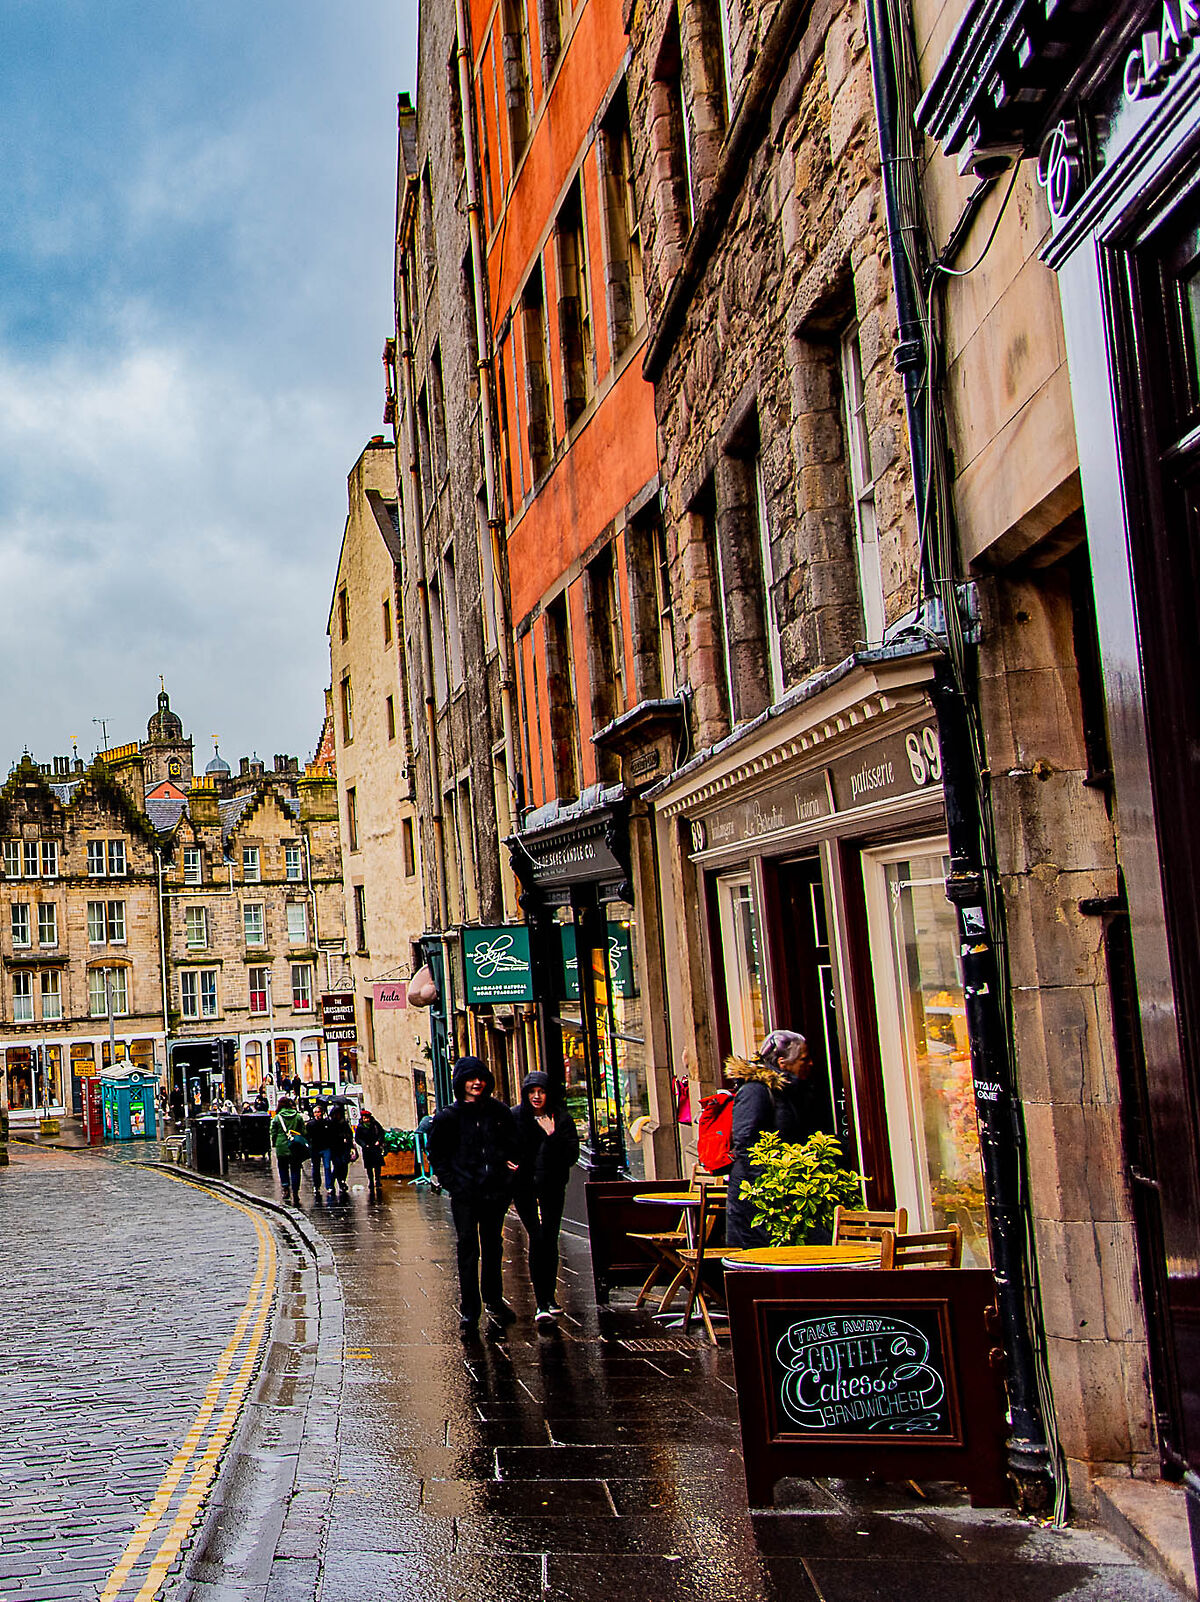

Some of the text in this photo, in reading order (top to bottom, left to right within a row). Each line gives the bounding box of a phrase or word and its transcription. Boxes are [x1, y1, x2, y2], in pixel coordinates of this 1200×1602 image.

[850, 727, 942, 801] patisserie 89
[691, 821, 704, 852] 89
[380, 990, 400, 1002] hula
[325, 1030, 356, 1040] VACANCIES
[794, 1321, 838, 1344] TAKE
[808, 1337, 888, 1373] COFFEE
[796, 1367, 872, 1407] Cakes
